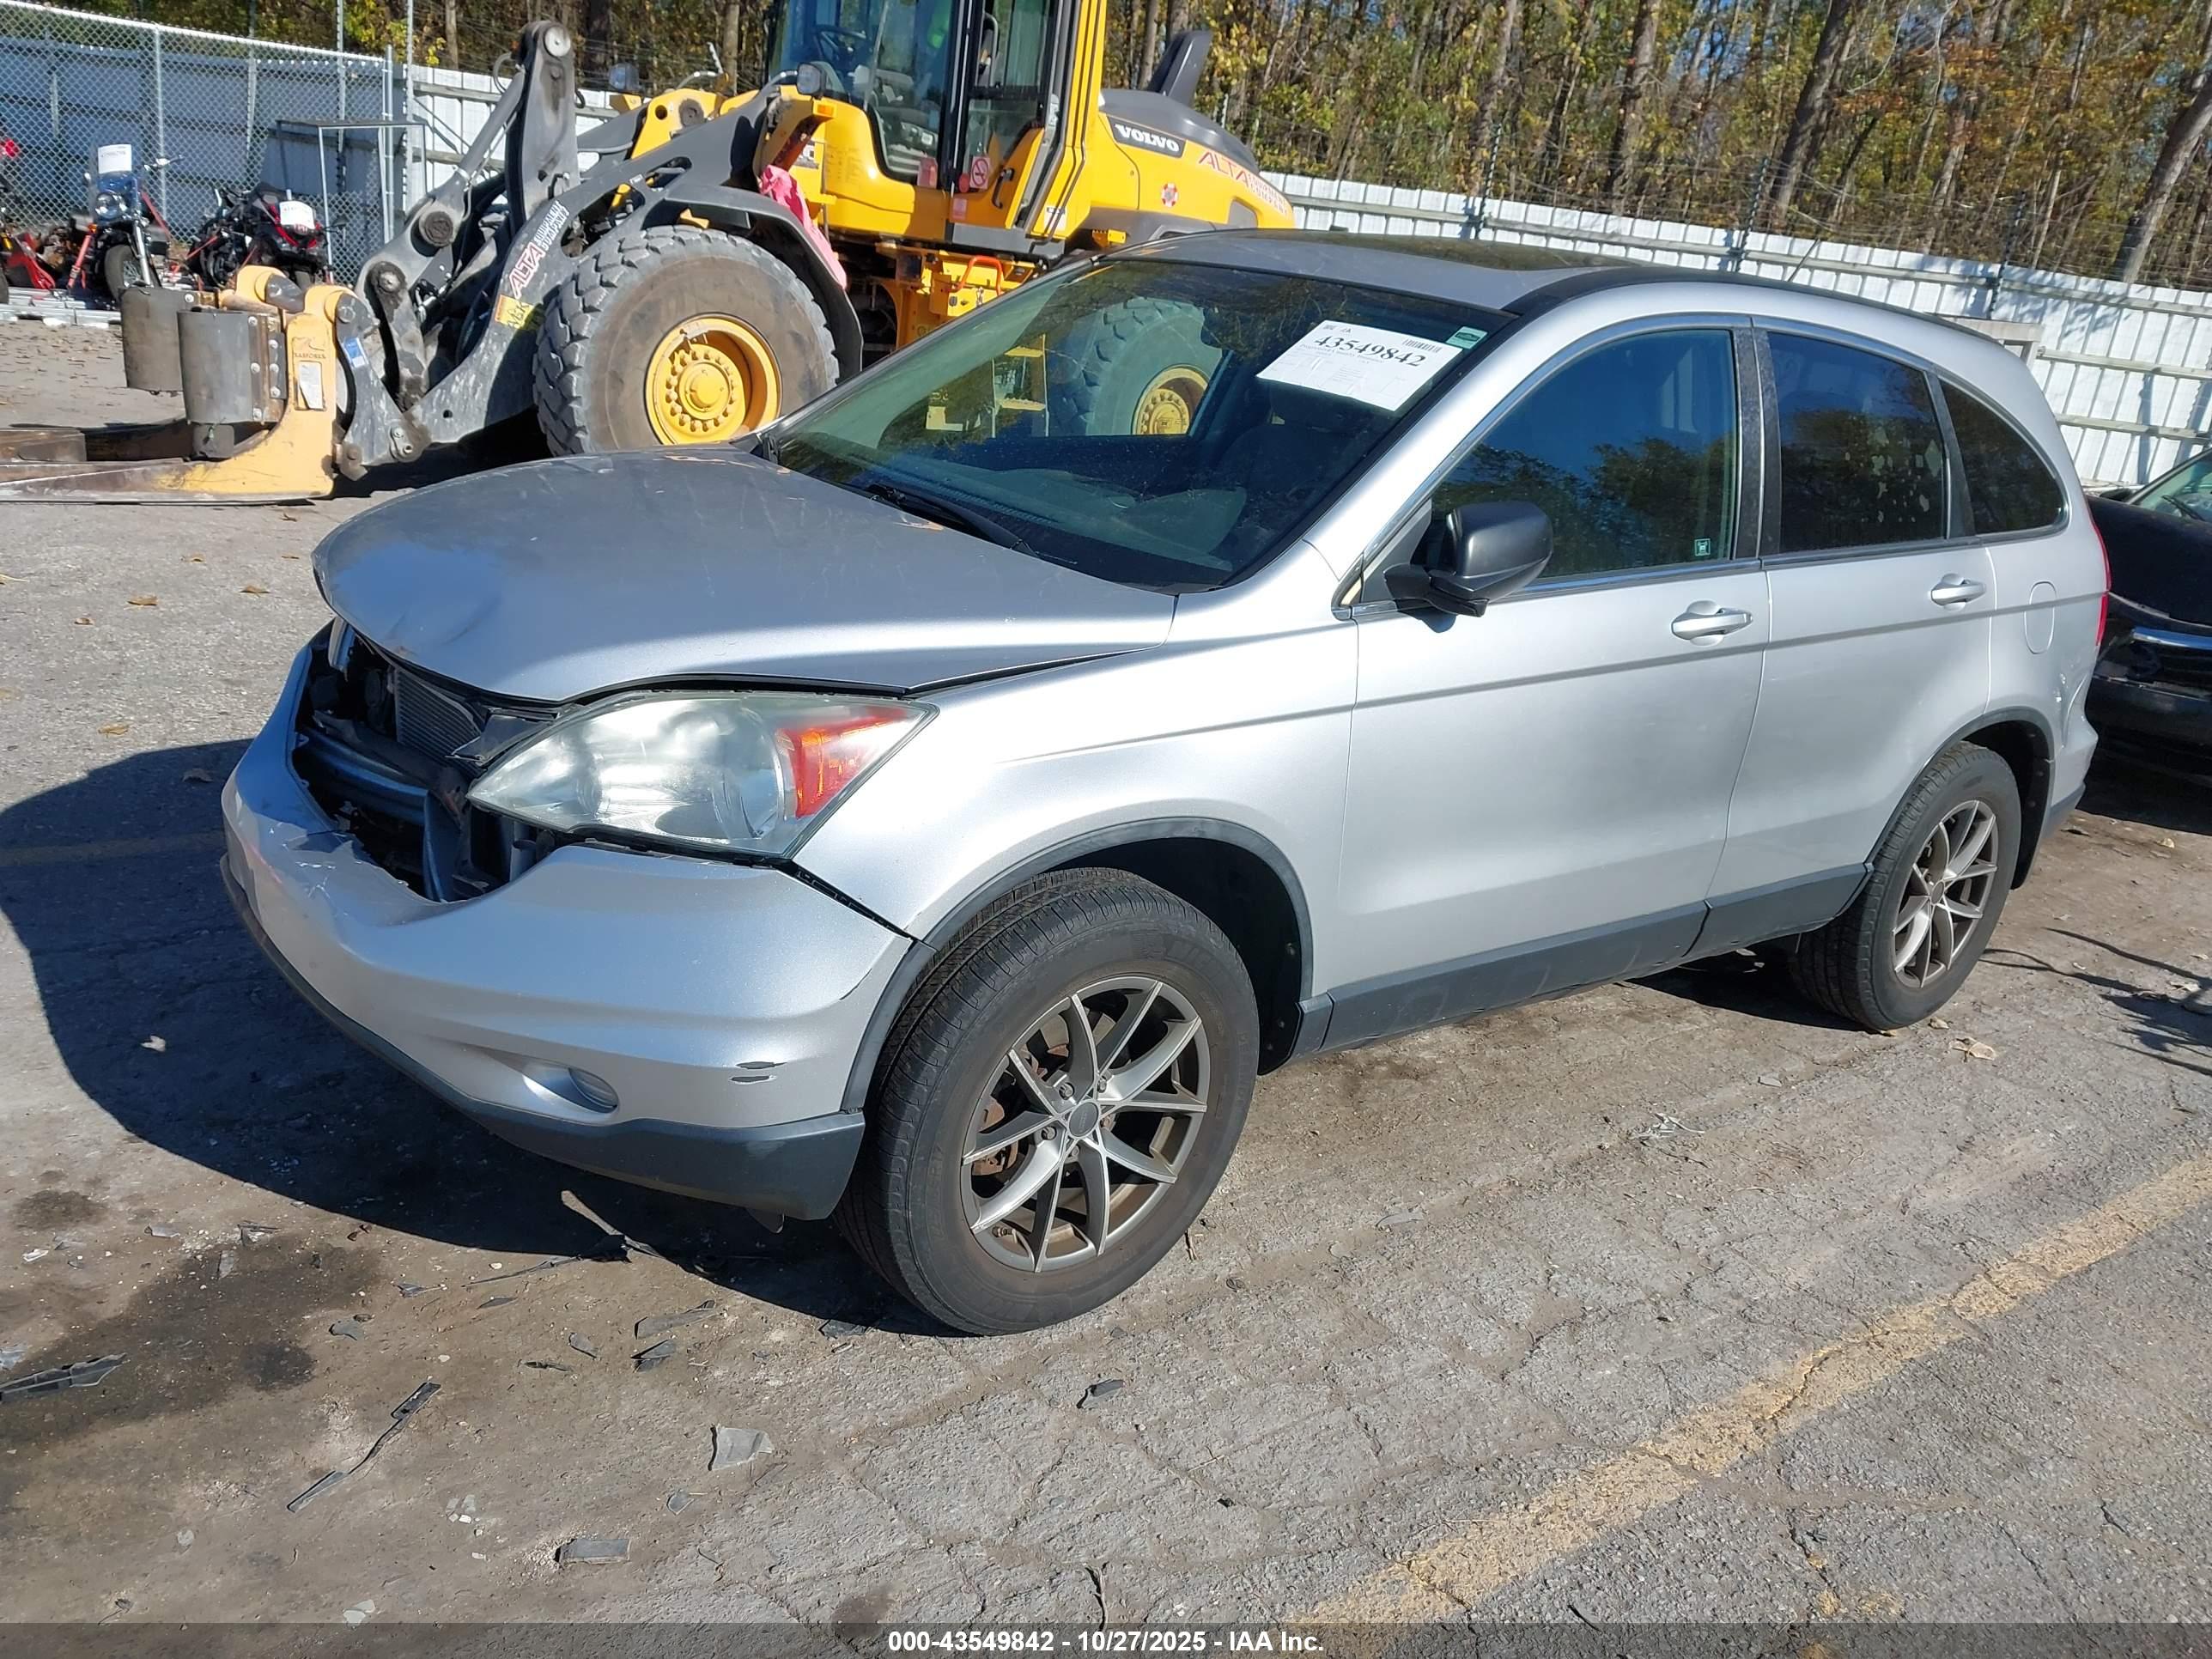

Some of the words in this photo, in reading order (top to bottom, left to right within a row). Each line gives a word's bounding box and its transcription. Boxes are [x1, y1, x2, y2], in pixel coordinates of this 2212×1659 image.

[1115, 123, 1180, 152] VOLVO
[1199, 151, 1249, 188] ALTA
[509, 241, 546, 300] ALTA
[1314, 336, 1425, 367] 43549842
